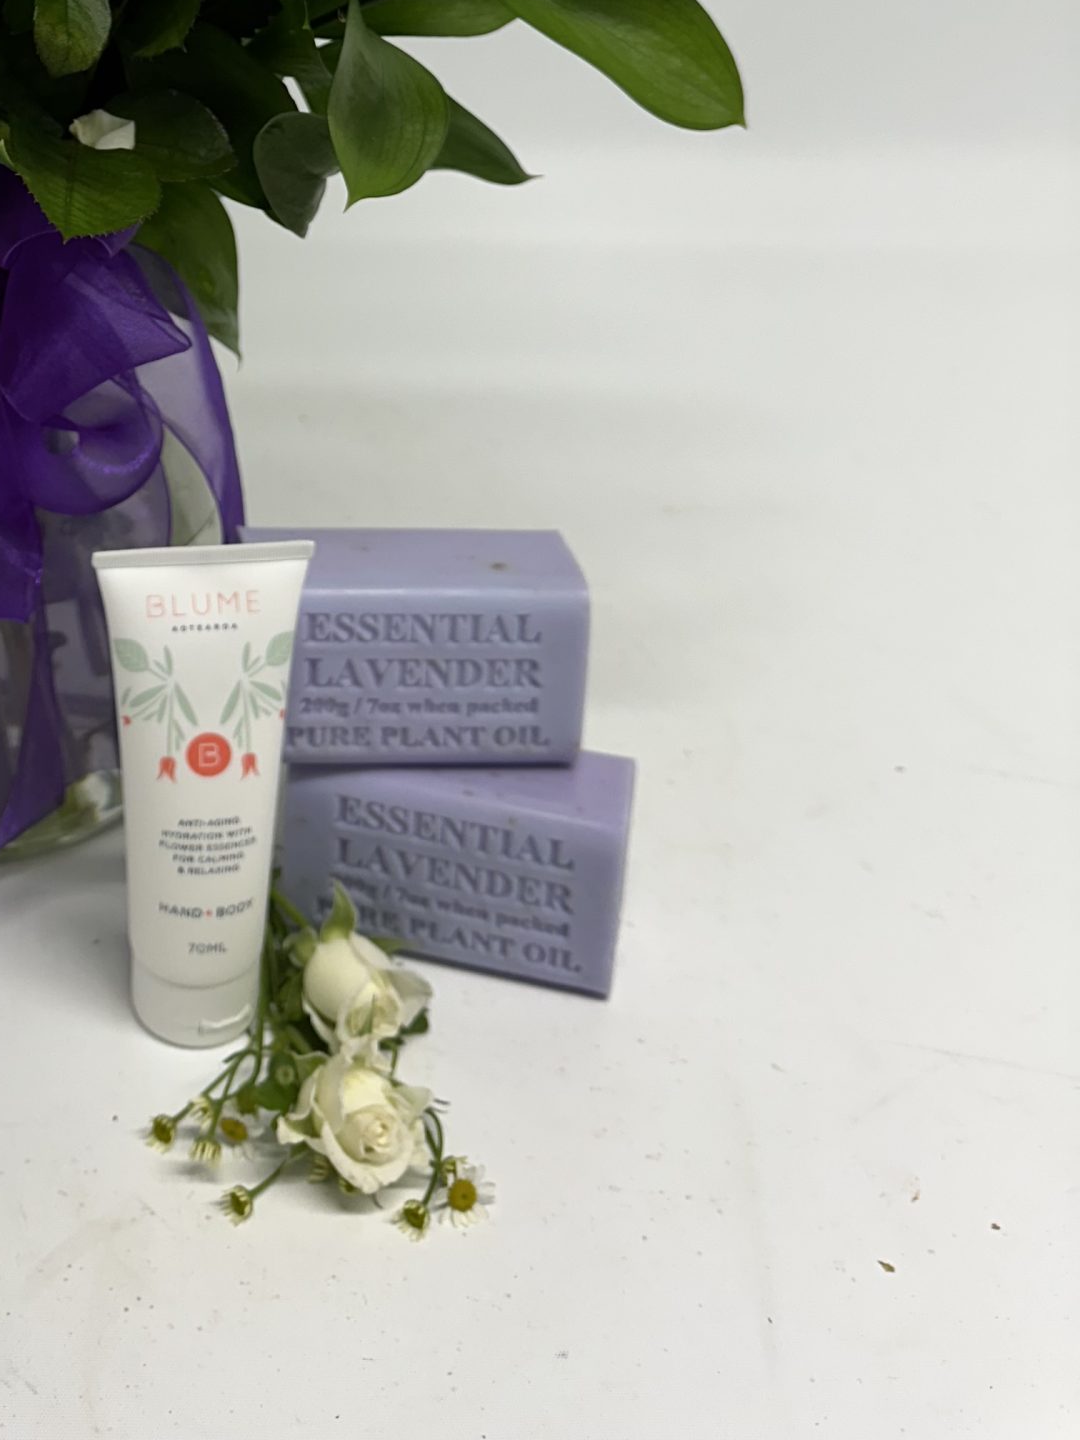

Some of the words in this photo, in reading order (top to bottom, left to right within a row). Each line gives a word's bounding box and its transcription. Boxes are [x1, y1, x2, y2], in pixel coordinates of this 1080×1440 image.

[146, 590, 262, 618] BLUME
[305, 612, 543, 644] ESSENTIAL
[305, 658, 543, 689] LAVENDER
[407, 697, 459, 714] when
[466, 697, 538, 717] packed
[286, 726, 372, 747] PURE
[380, 726, 486, 748] PLANT
[494, 725, 551, 747] OIL
[198, 742, 220, 767] B
[226, 826, 252, 838] WITH
[335, 795, 574, 870] ESSENTIAL
[336, 838, 574, 914] LAVENDER
[158, 901, 203, 918] HAND
[216, 898, 253, 918] BODY
[495, 912, 569, 938] packed
[411, 916, 517, 958] PLANT
[523, 941, 584, 973] OIL
